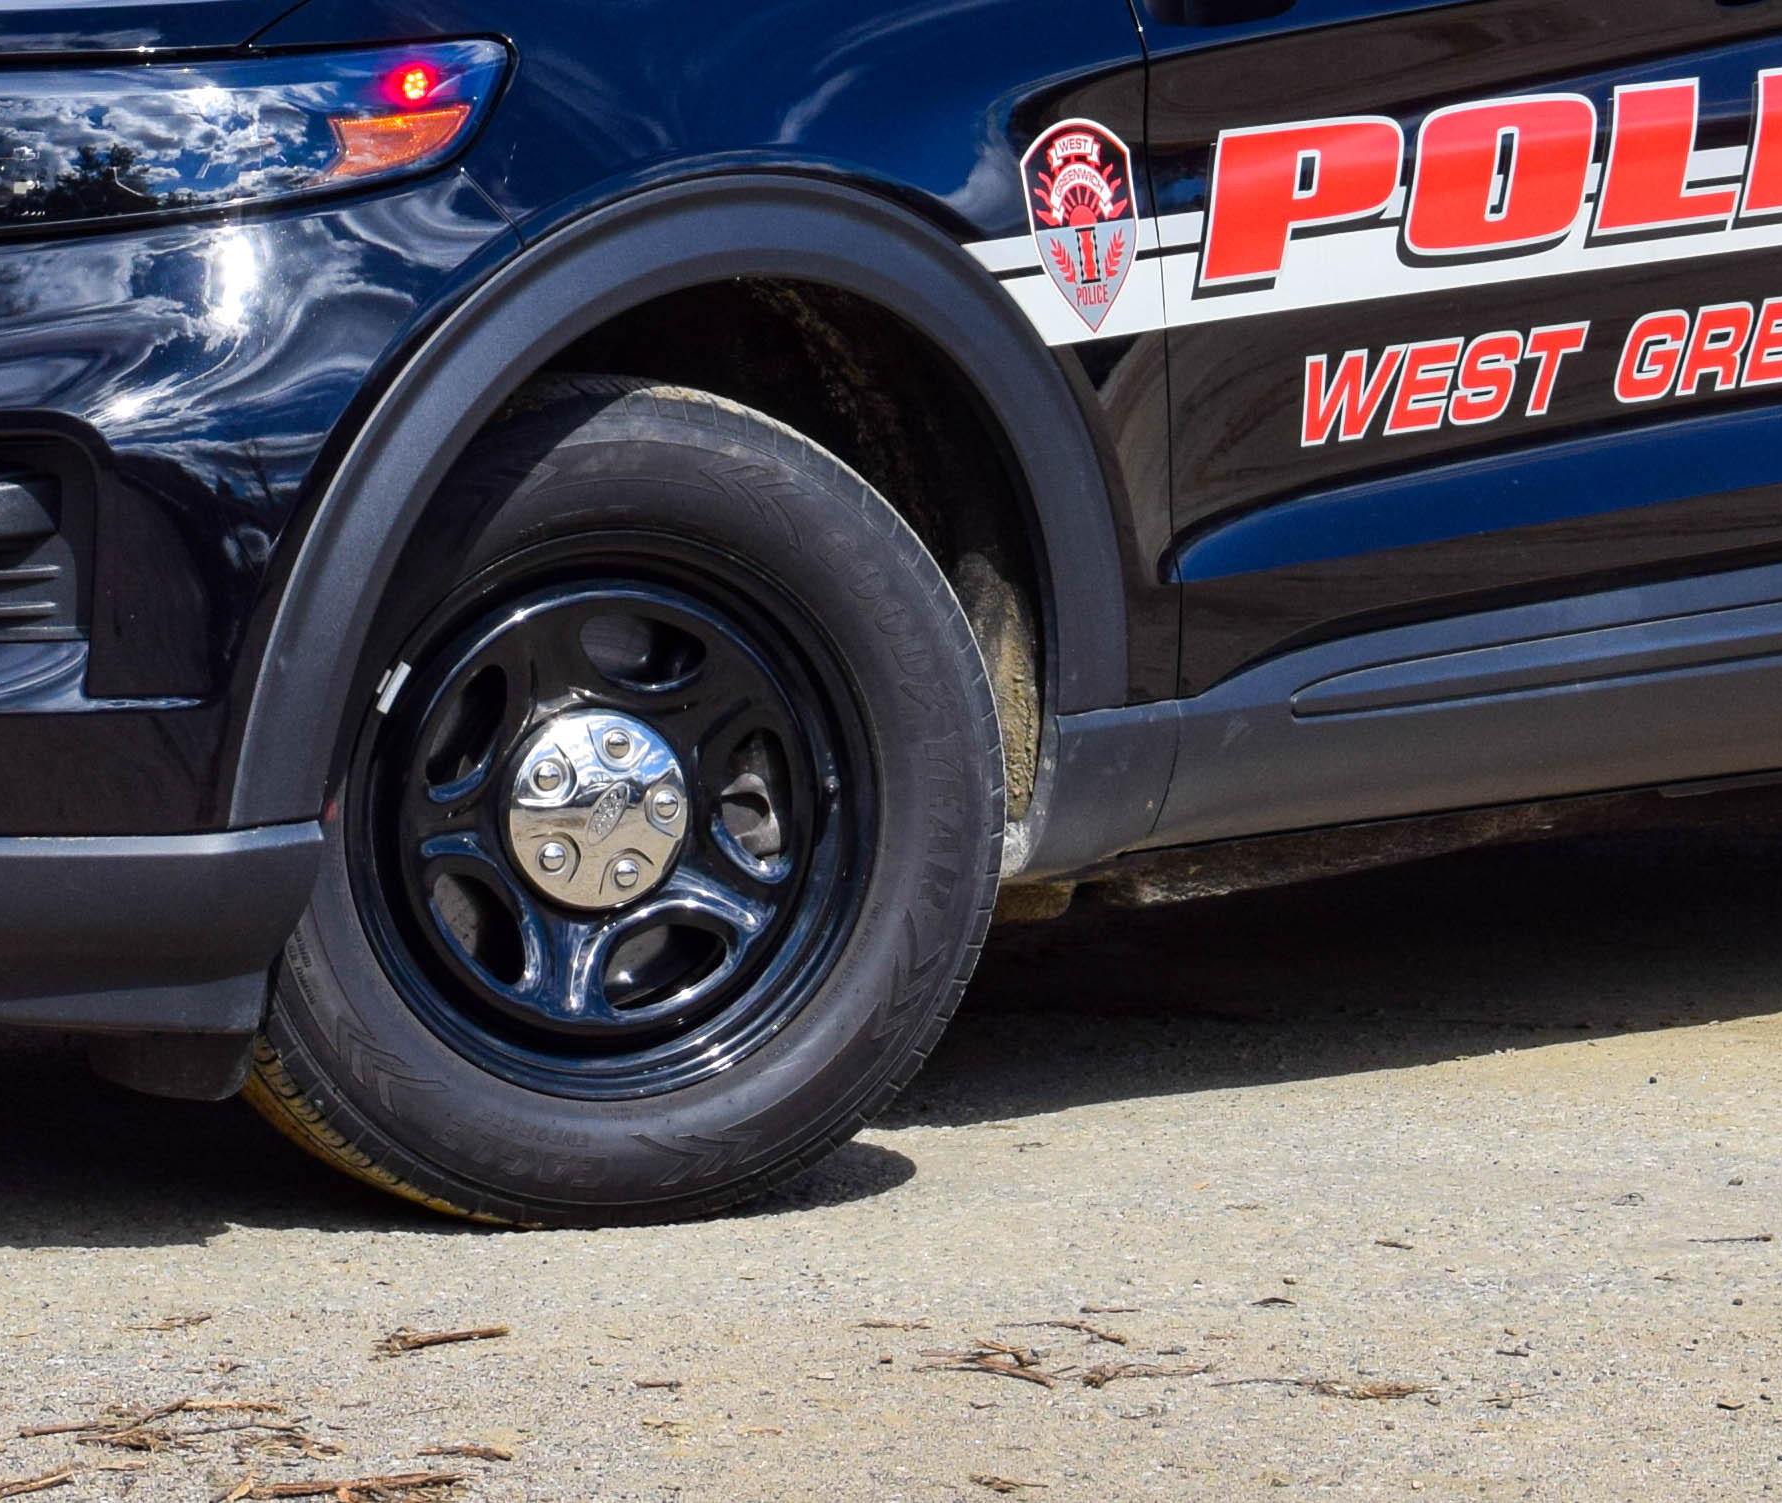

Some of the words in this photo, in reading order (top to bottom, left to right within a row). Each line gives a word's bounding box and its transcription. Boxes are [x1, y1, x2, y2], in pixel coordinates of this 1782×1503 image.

[1058, 138, 1089, 152] WEST
[1054, 167, 1104, 197] GREENWICH
[1076, 284, 1110, 308] POLICE
[1300, 320, 1591, 449] WEST
